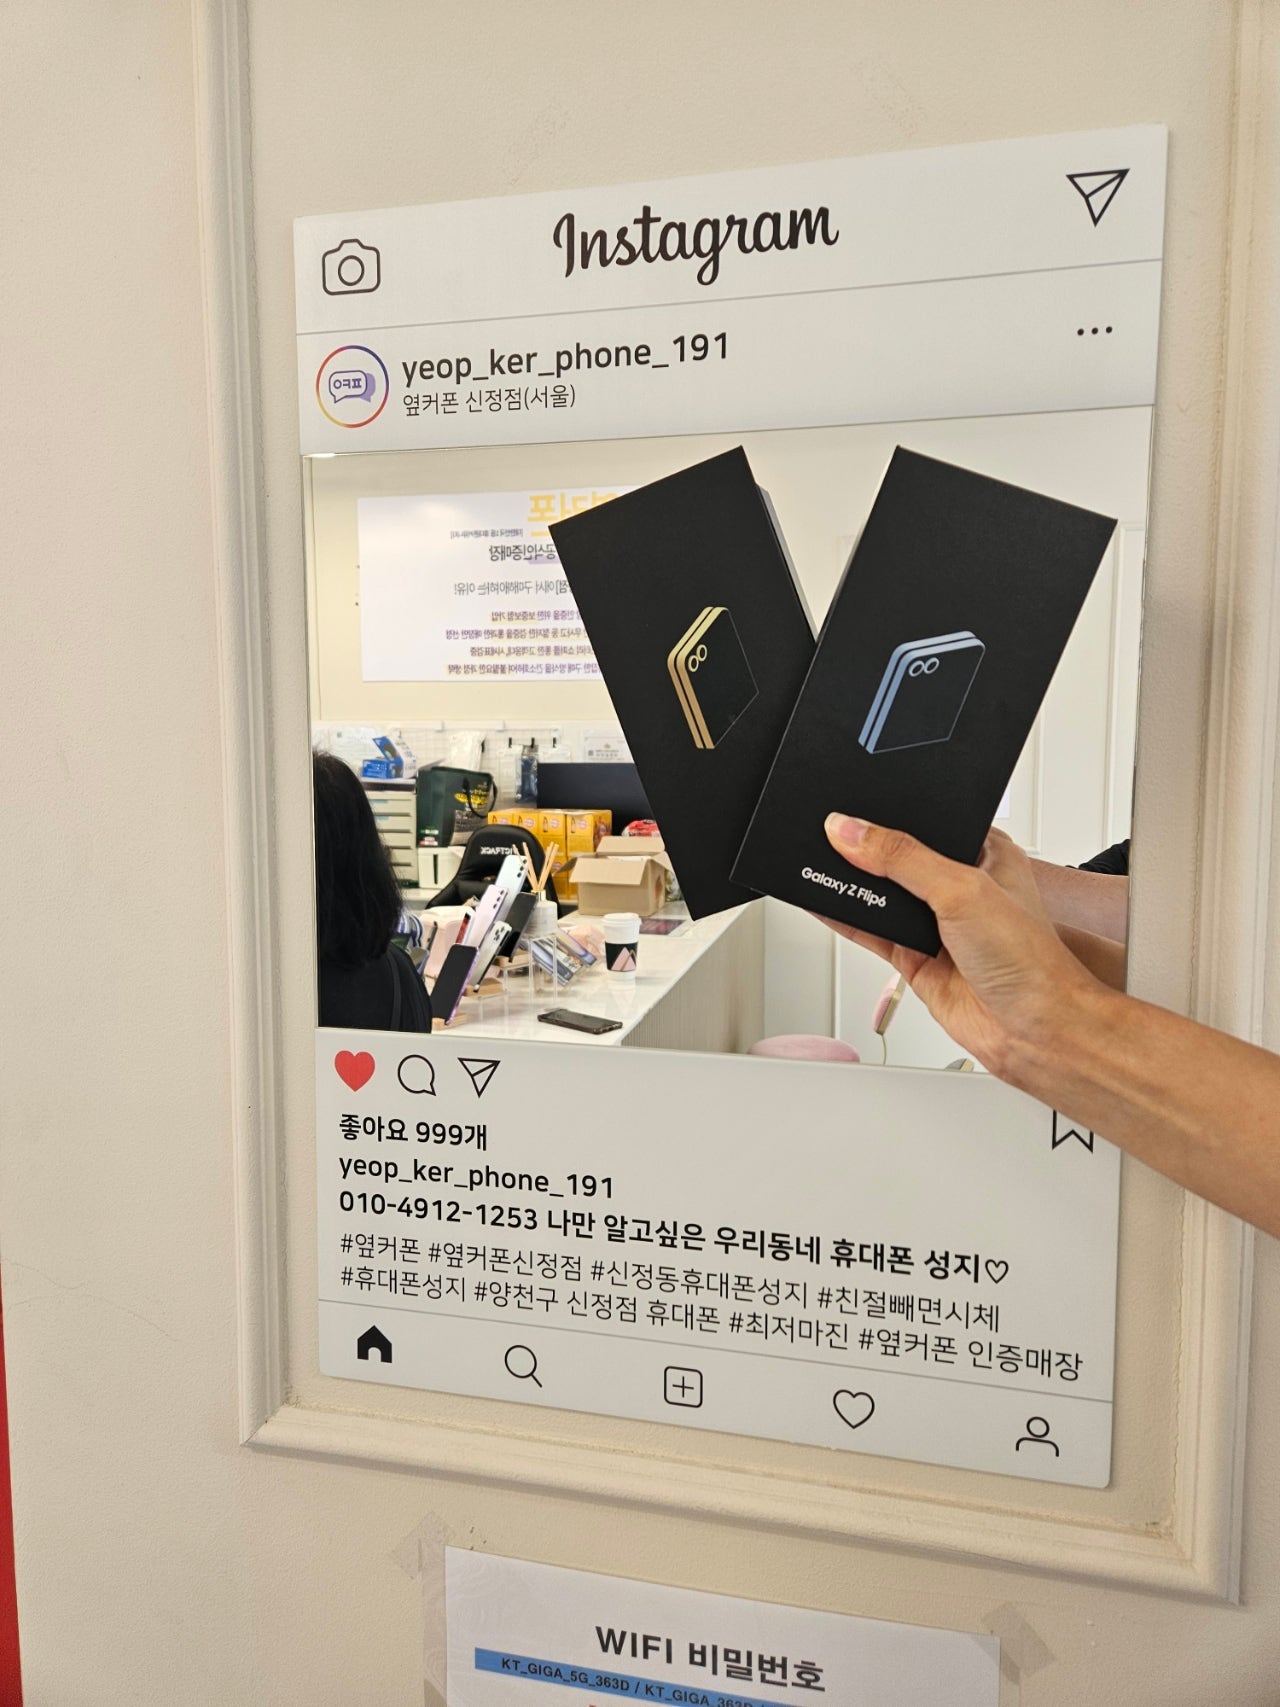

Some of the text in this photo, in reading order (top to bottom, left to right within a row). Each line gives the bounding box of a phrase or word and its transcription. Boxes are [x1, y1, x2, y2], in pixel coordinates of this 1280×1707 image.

[553, 205, 839, 286] Instagram
[402, 331, 729, 387] yeop_ker_phone_191
[403, 383, 576, 417] 옆커폰 신정점(서울)
[801, 867, 887, 907] Galaxy Z Flip6
[339, 1114, 487, 1150] 좋아요 999개
[339, 1157, 614, 1198] yeop_ker_phone_191
[339, 1191, 538, 1230] 010-4912-1253
[548, 1210, 595, 1239] 나만
[604, 1214, 706, 1252] 알고싶은
[714, 1226, 821, 1264] 우리동네
[830, 1238, 915, 1275] 휴대폰
[340, 1233, 1000, 1333] #옆커폰 #옆커폰신정점 #신정동휴대폰성지 #친절빼면시체
[341, 1265, 1084, 1382] #휴대폰성지 #양천구 신정점 휴대폰 #최저마진 #옆커폰 인증매장
[502, 1658, 630, 1692] KT_GIGA_5G_363D
[595, 1626, 826, 1692] WIFI 비밀번호
